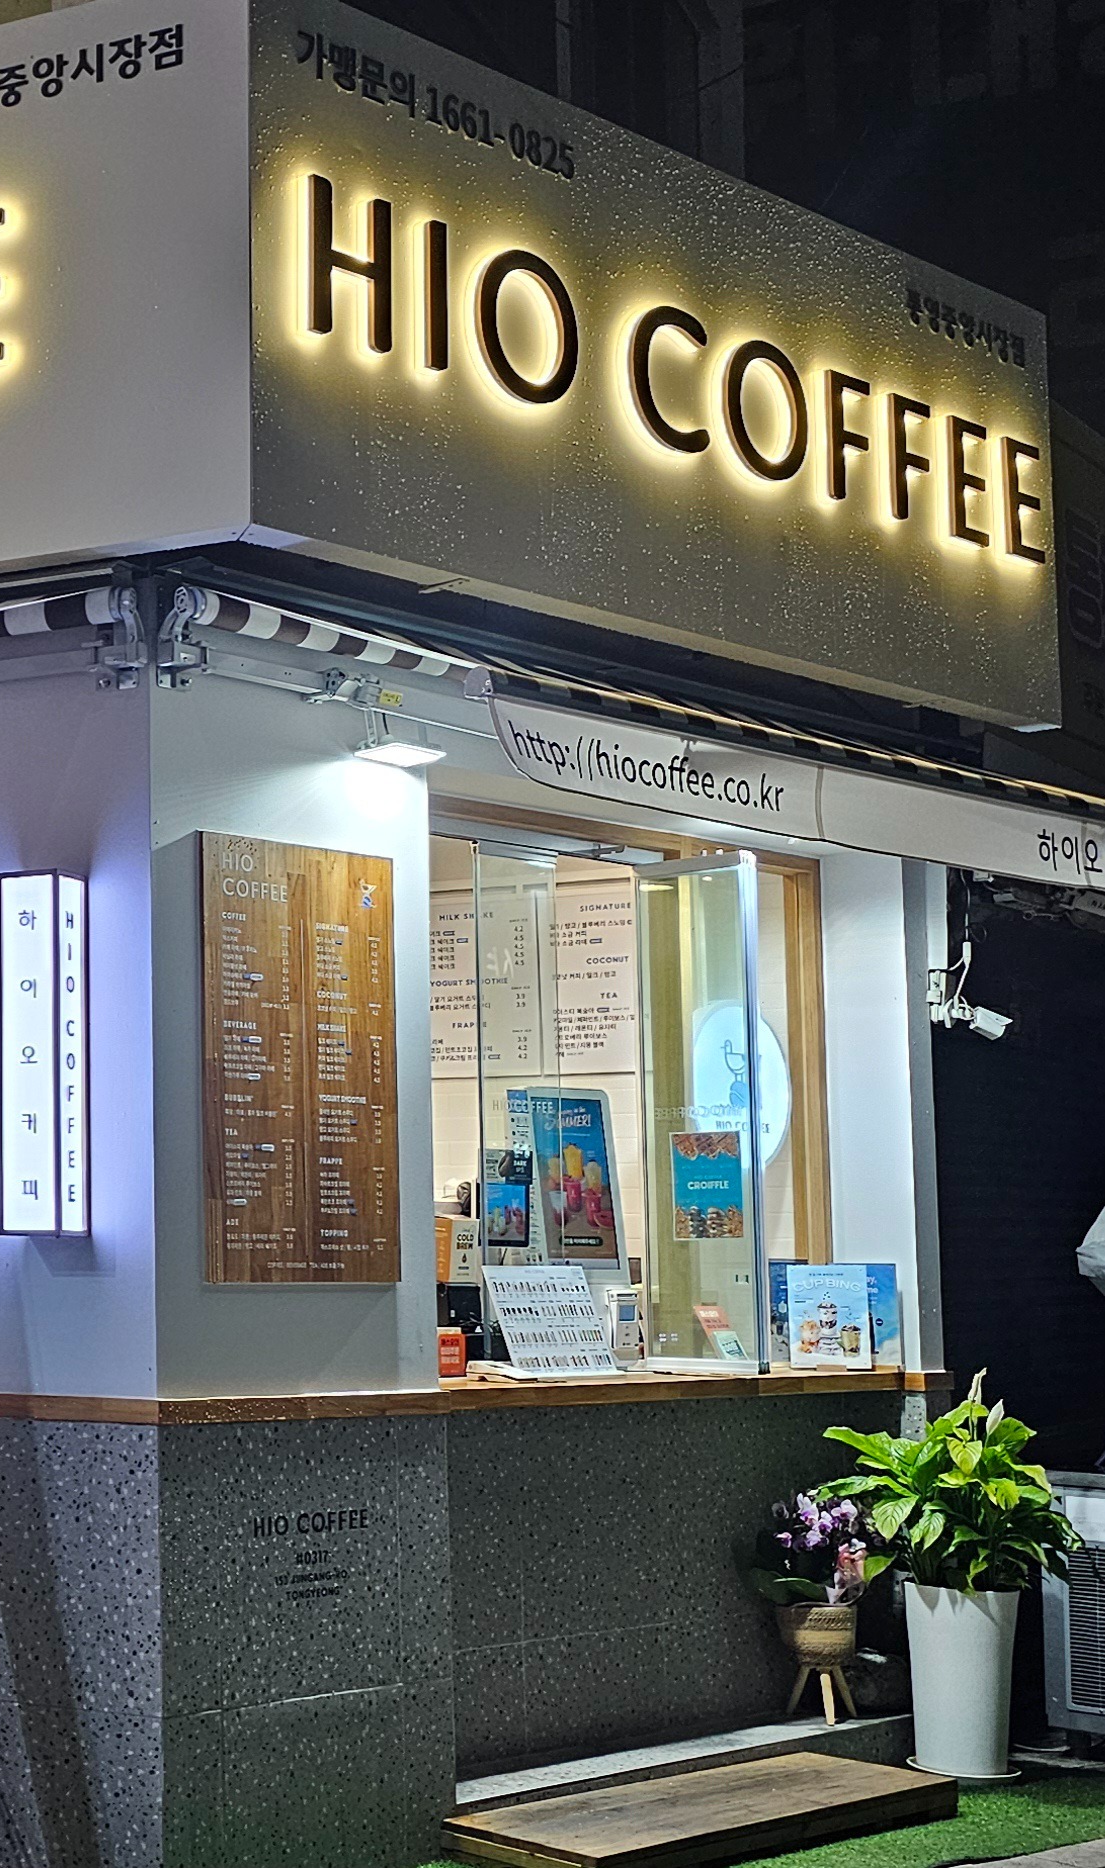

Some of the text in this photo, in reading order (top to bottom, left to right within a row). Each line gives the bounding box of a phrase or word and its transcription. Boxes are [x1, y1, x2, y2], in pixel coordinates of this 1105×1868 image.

[296, 29, 575, 180] 가맹문의 1661-0825
[305, 172, 1046, 565] HIO COFFEE
[507, 720, 785, 812] http://hiocoffee.co.kr
[1037, 828, 1103, 875] 하이오
[221, 851, 254, 873] HIO
[222, 877, 288, 903] COFFEE
[579, 902, 632, 913] SIGNATURE
[221, 911, 246, 921] COFFEE
[439, 912, 494, 921] MILK SHKE
[586, 955, 629, 965] COCONUT
[223, 1020, 257, 1030] BEVERAGE
[224, 1127, 238, 1136] TEA
[687, 1181, 730, 1191] CROIFFLE
[456, 1233, 474, 1242] COLD
[456, 1242, 474, 1250] BREW
[793, 1278, 862, 1293] CUP BING
[253, 1508, 369, 1538] HIO COFFEE
[296, 1549, 329, 1565] #0317
